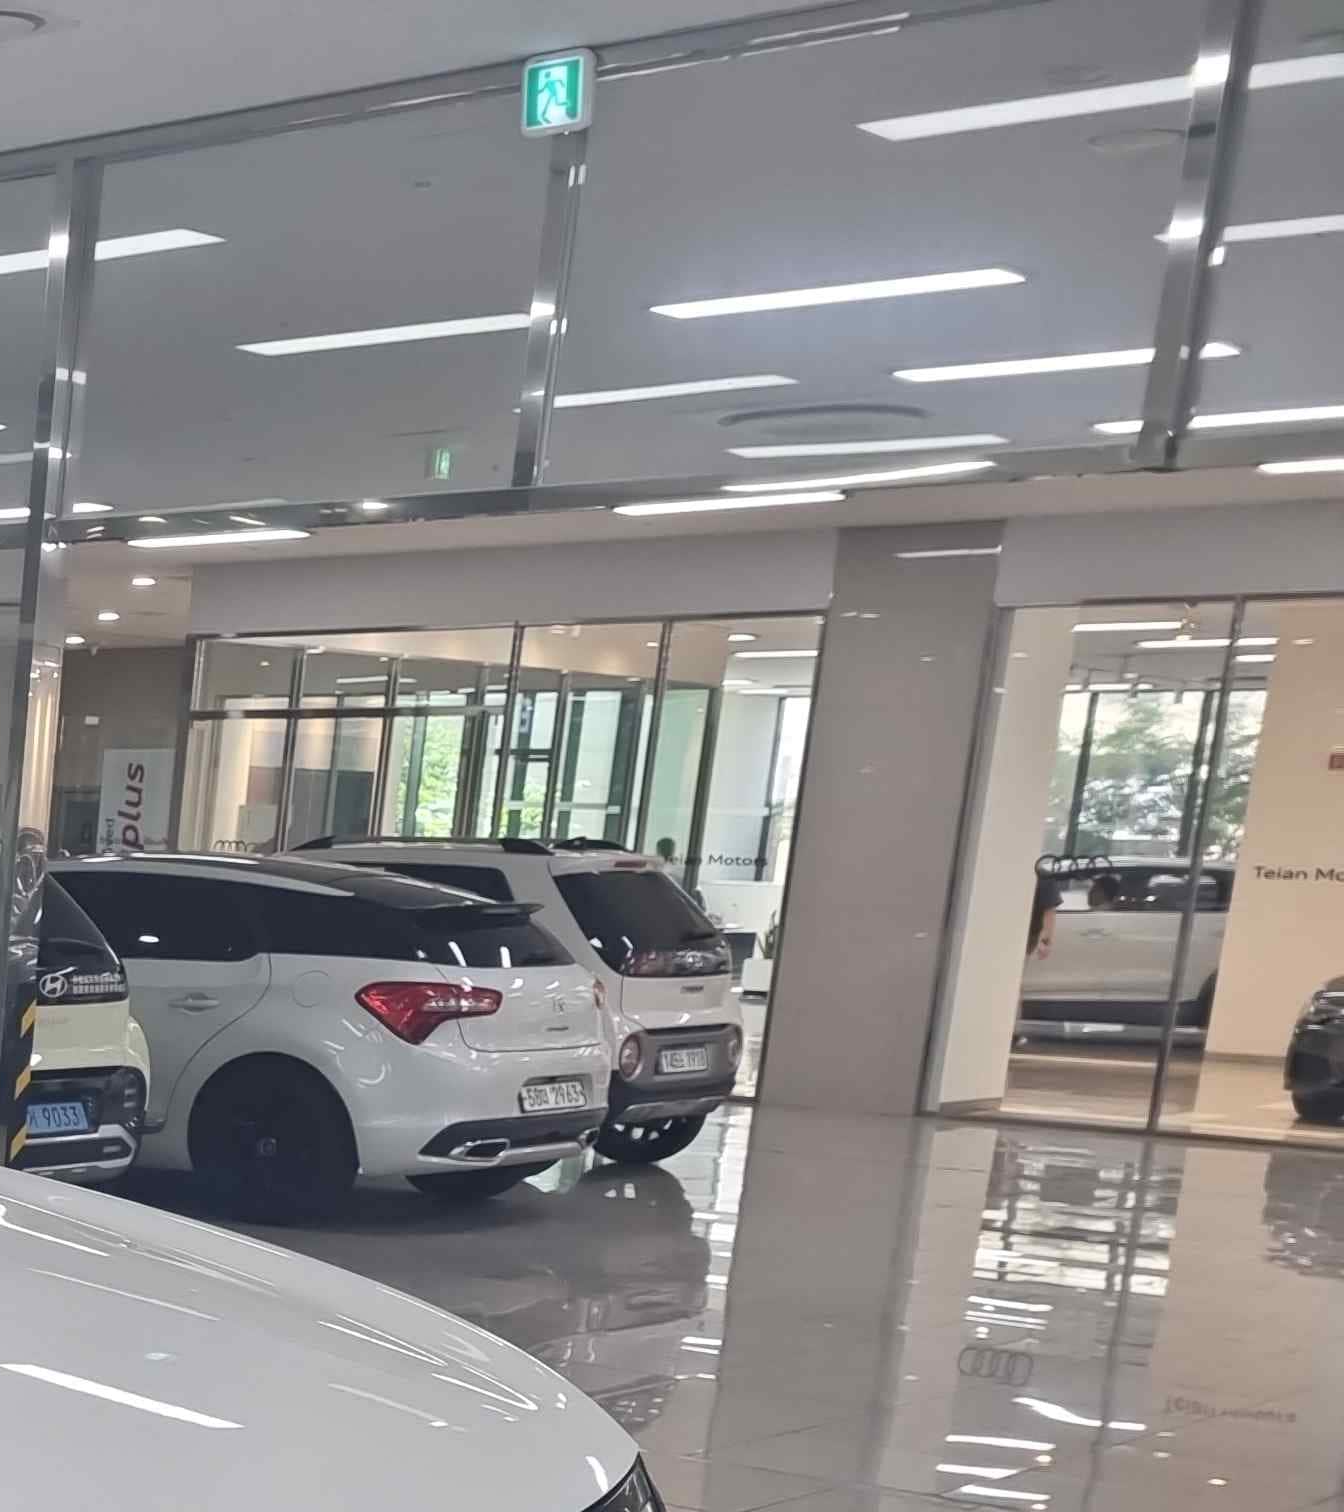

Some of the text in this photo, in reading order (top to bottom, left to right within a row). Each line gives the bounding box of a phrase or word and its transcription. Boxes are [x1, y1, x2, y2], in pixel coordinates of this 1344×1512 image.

[117, 762, 145, 850] plus
[1254, 866, 1308, 880] Teian
[42, 1106, 80, 1127] 9033
